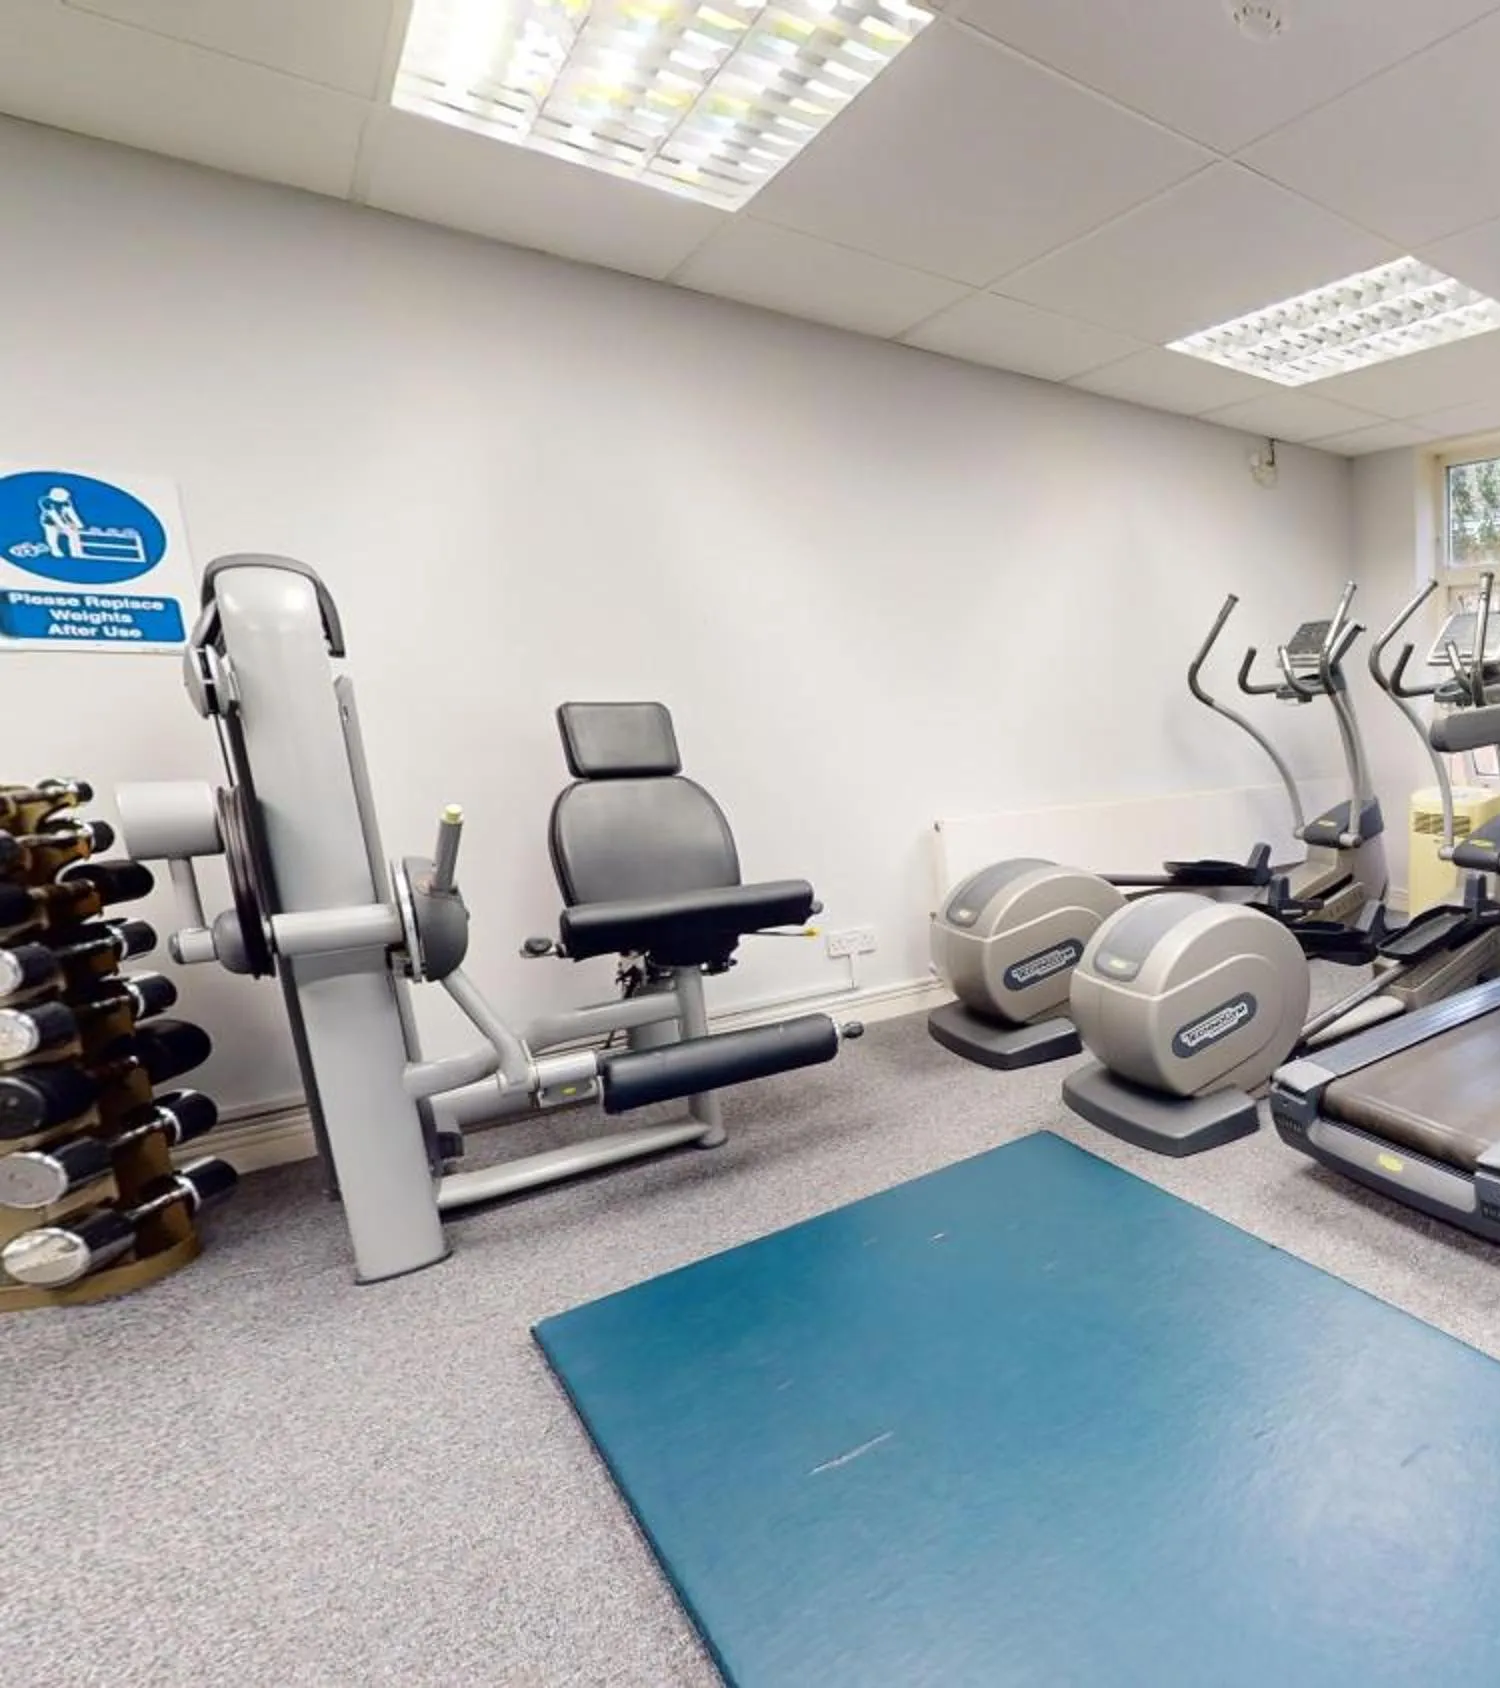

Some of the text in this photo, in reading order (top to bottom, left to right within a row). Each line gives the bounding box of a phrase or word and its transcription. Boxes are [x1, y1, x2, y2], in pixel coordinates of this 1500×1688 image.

[8, 591, 165, 611] Please Replace
[49, 608, 133, 624] Weights
[48, 624, 142, 638] After Use
